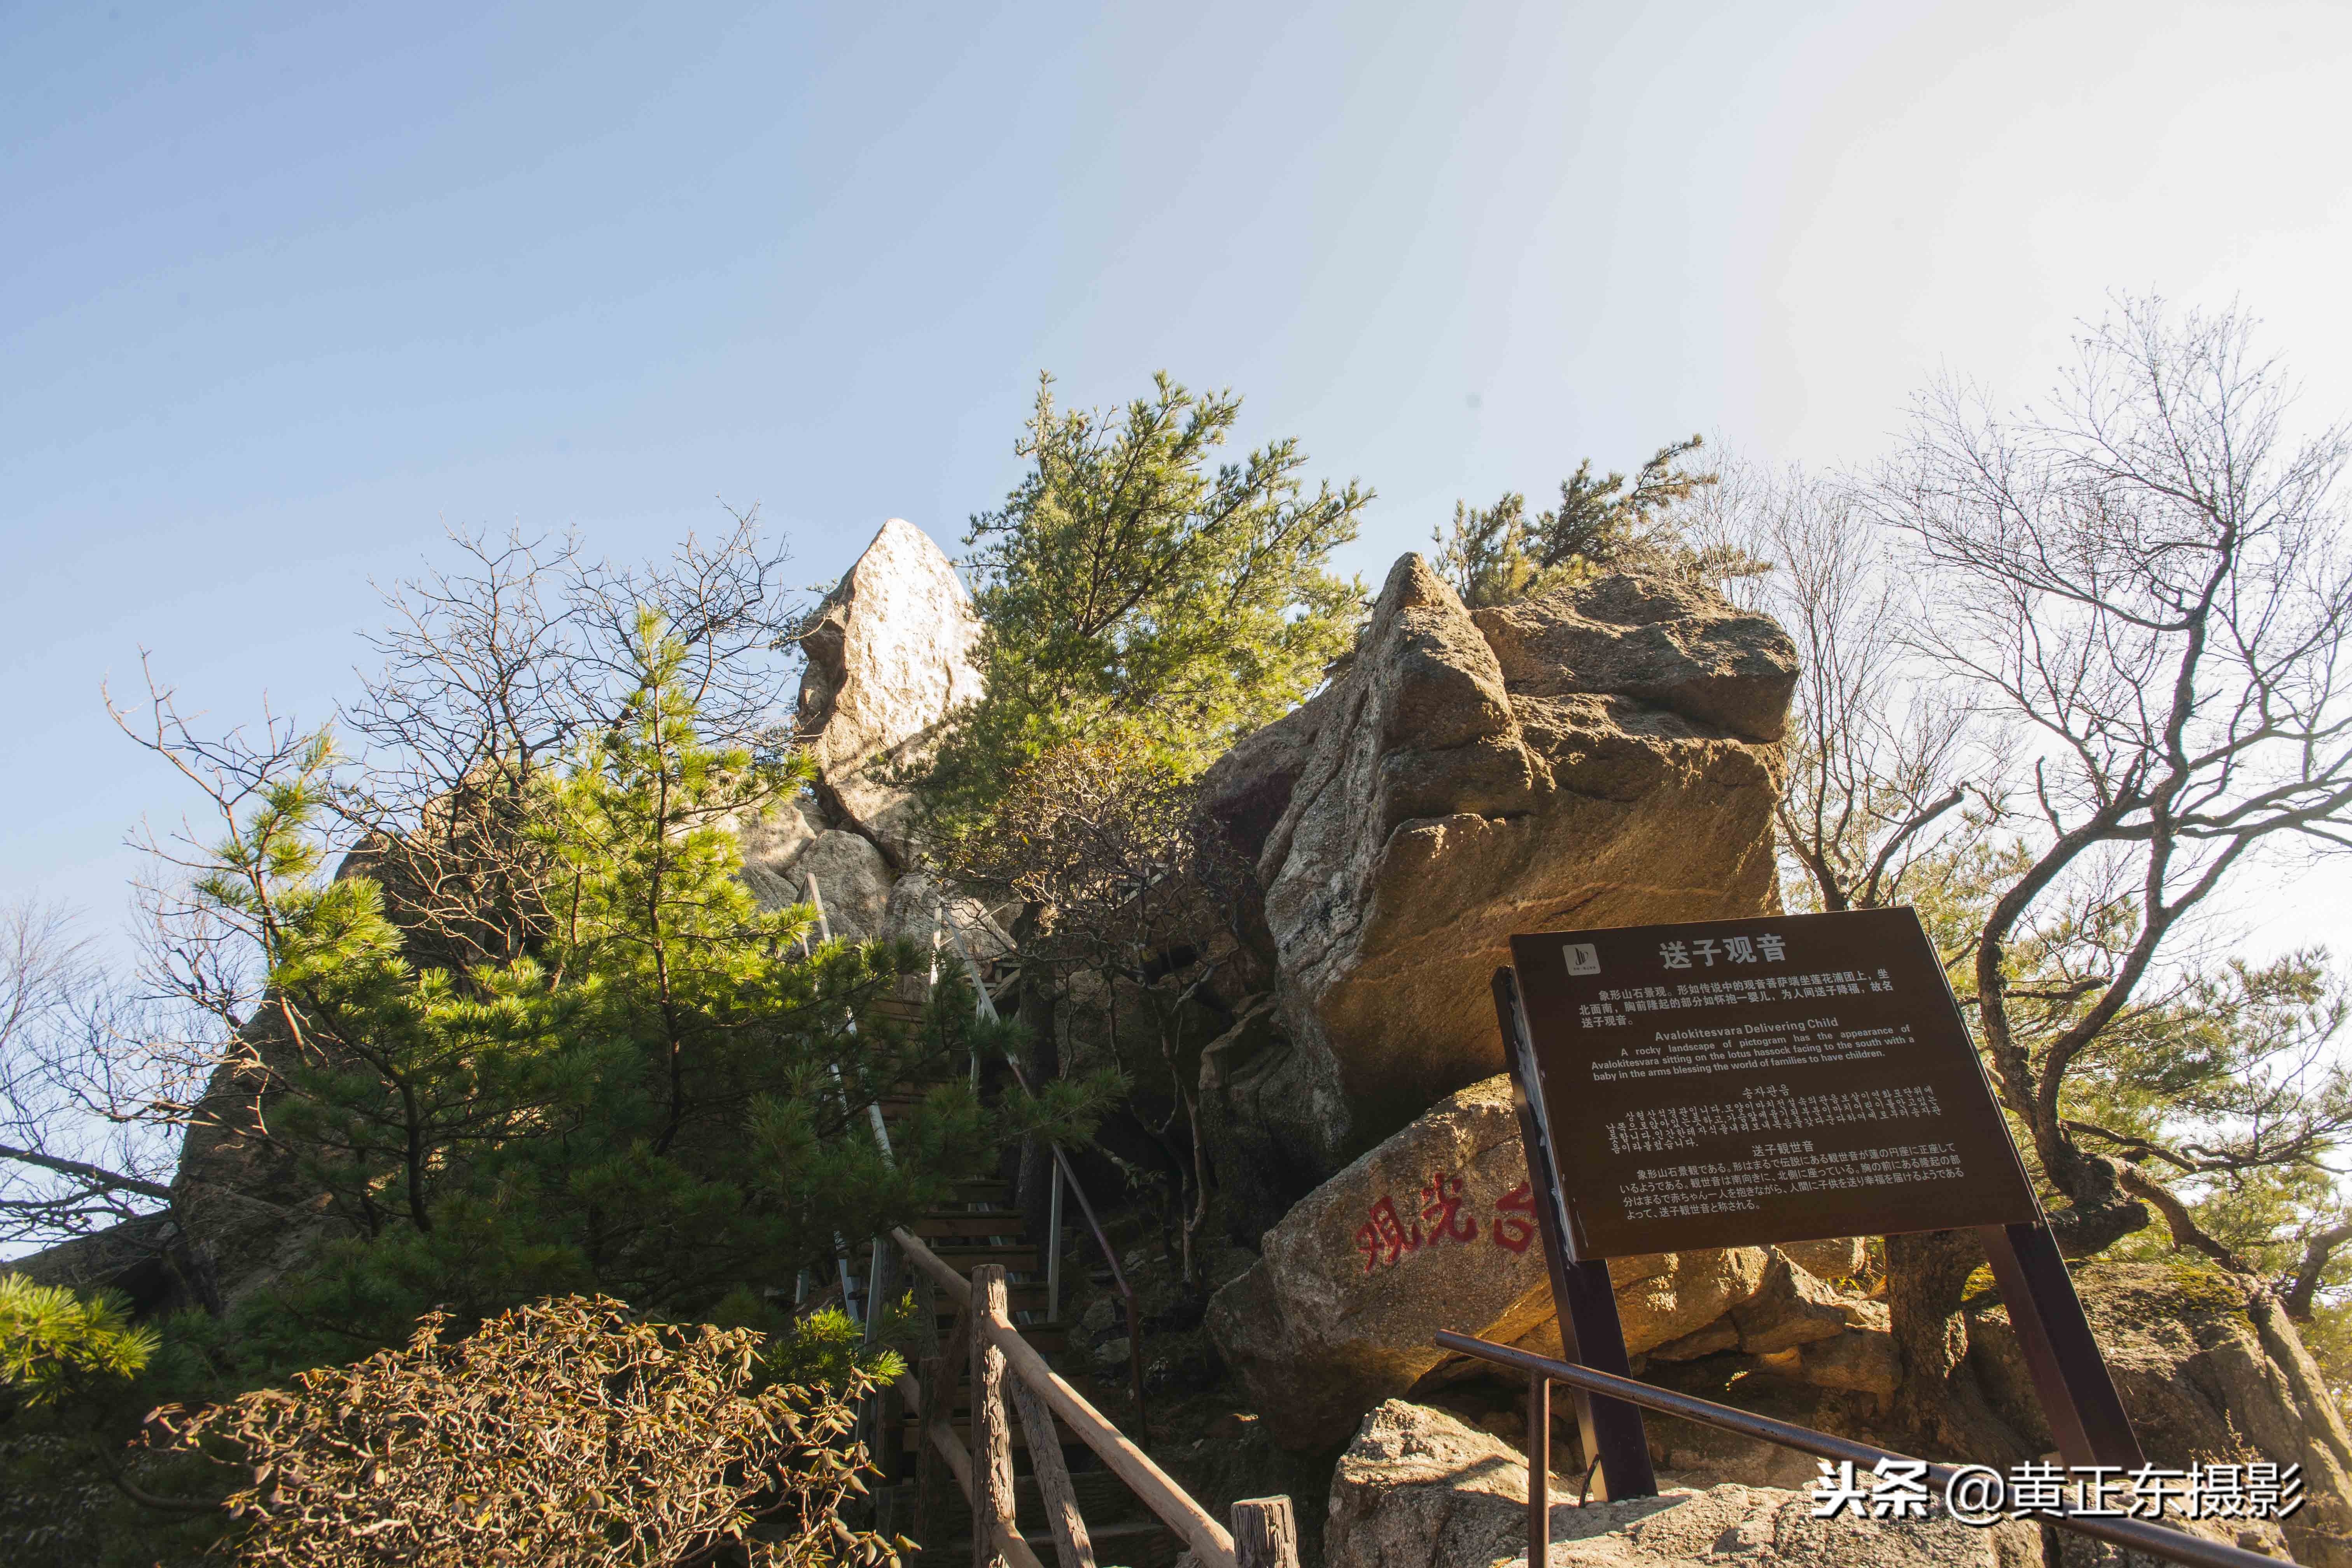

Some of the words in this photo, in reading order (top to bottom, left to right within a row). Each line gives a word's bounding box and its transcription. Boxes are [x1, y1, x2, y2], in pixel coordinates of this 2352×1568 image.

[1659, 933, 1786, 970] 送子观音
[1581, 1014, 1633, 1029] 送子观音。
[1655, 1027, 1743, 1041] Avalokitesvara
[1744, 1021, 1806, 1034] Delivering
[1807, 1017, 1839, 1028] Child
[1591, 1059, 1659, 1070] Avalokitesvara
[1662, 1055, 1692, 1064] sitting
[1709, 1052, 1726, 1060] the
[1727, 1050, 1752, 1059] lotus
[1754, 1046, 1791, 1056] hassock
[1793, 1044, 1822, 1053] facing
[1836, 1041, 1853, 1049] the
[1855, 1038, 1882, 1048] south
[1884, 1036, 1906, 1045] with
[1621, 1048, 1629, 1057] A
[1635, 1046, 1661, 1055] rocky
[1668, 1043, 1715, 1053] landscape
[1722, 1040, 1732, 1048] of
[1739, 1037, 1787, 1048] pictogram
[1793, 1034, 1811, 1042] has
[1816, 1032, 1833, 1040] the
[1840, 1028, 1894, 1039] appearance
[1900, 1024, 1911, 1033] of
[1593, 1072, 1616, 1081] baby
[1618, 1071, 1628, 1079] in
[1629, 1069, 1646, 1078] the
[1648, 1068, 1671, 1076] arms
[1673, 1064, 1712, 1074] blessing
[1713, 1062, 1729, 1071] the
[1730, 1059, 1758, 1069] world
[1759, 1058, 1769, 1067] of
[1770, 1056, 1808, 1066] families
[1845, 1050, 1885, 1060] children.
[1742, 1084, 1789, 1099] 송자관음
[1752, 1140, 1814, 1157] 送子観世音
